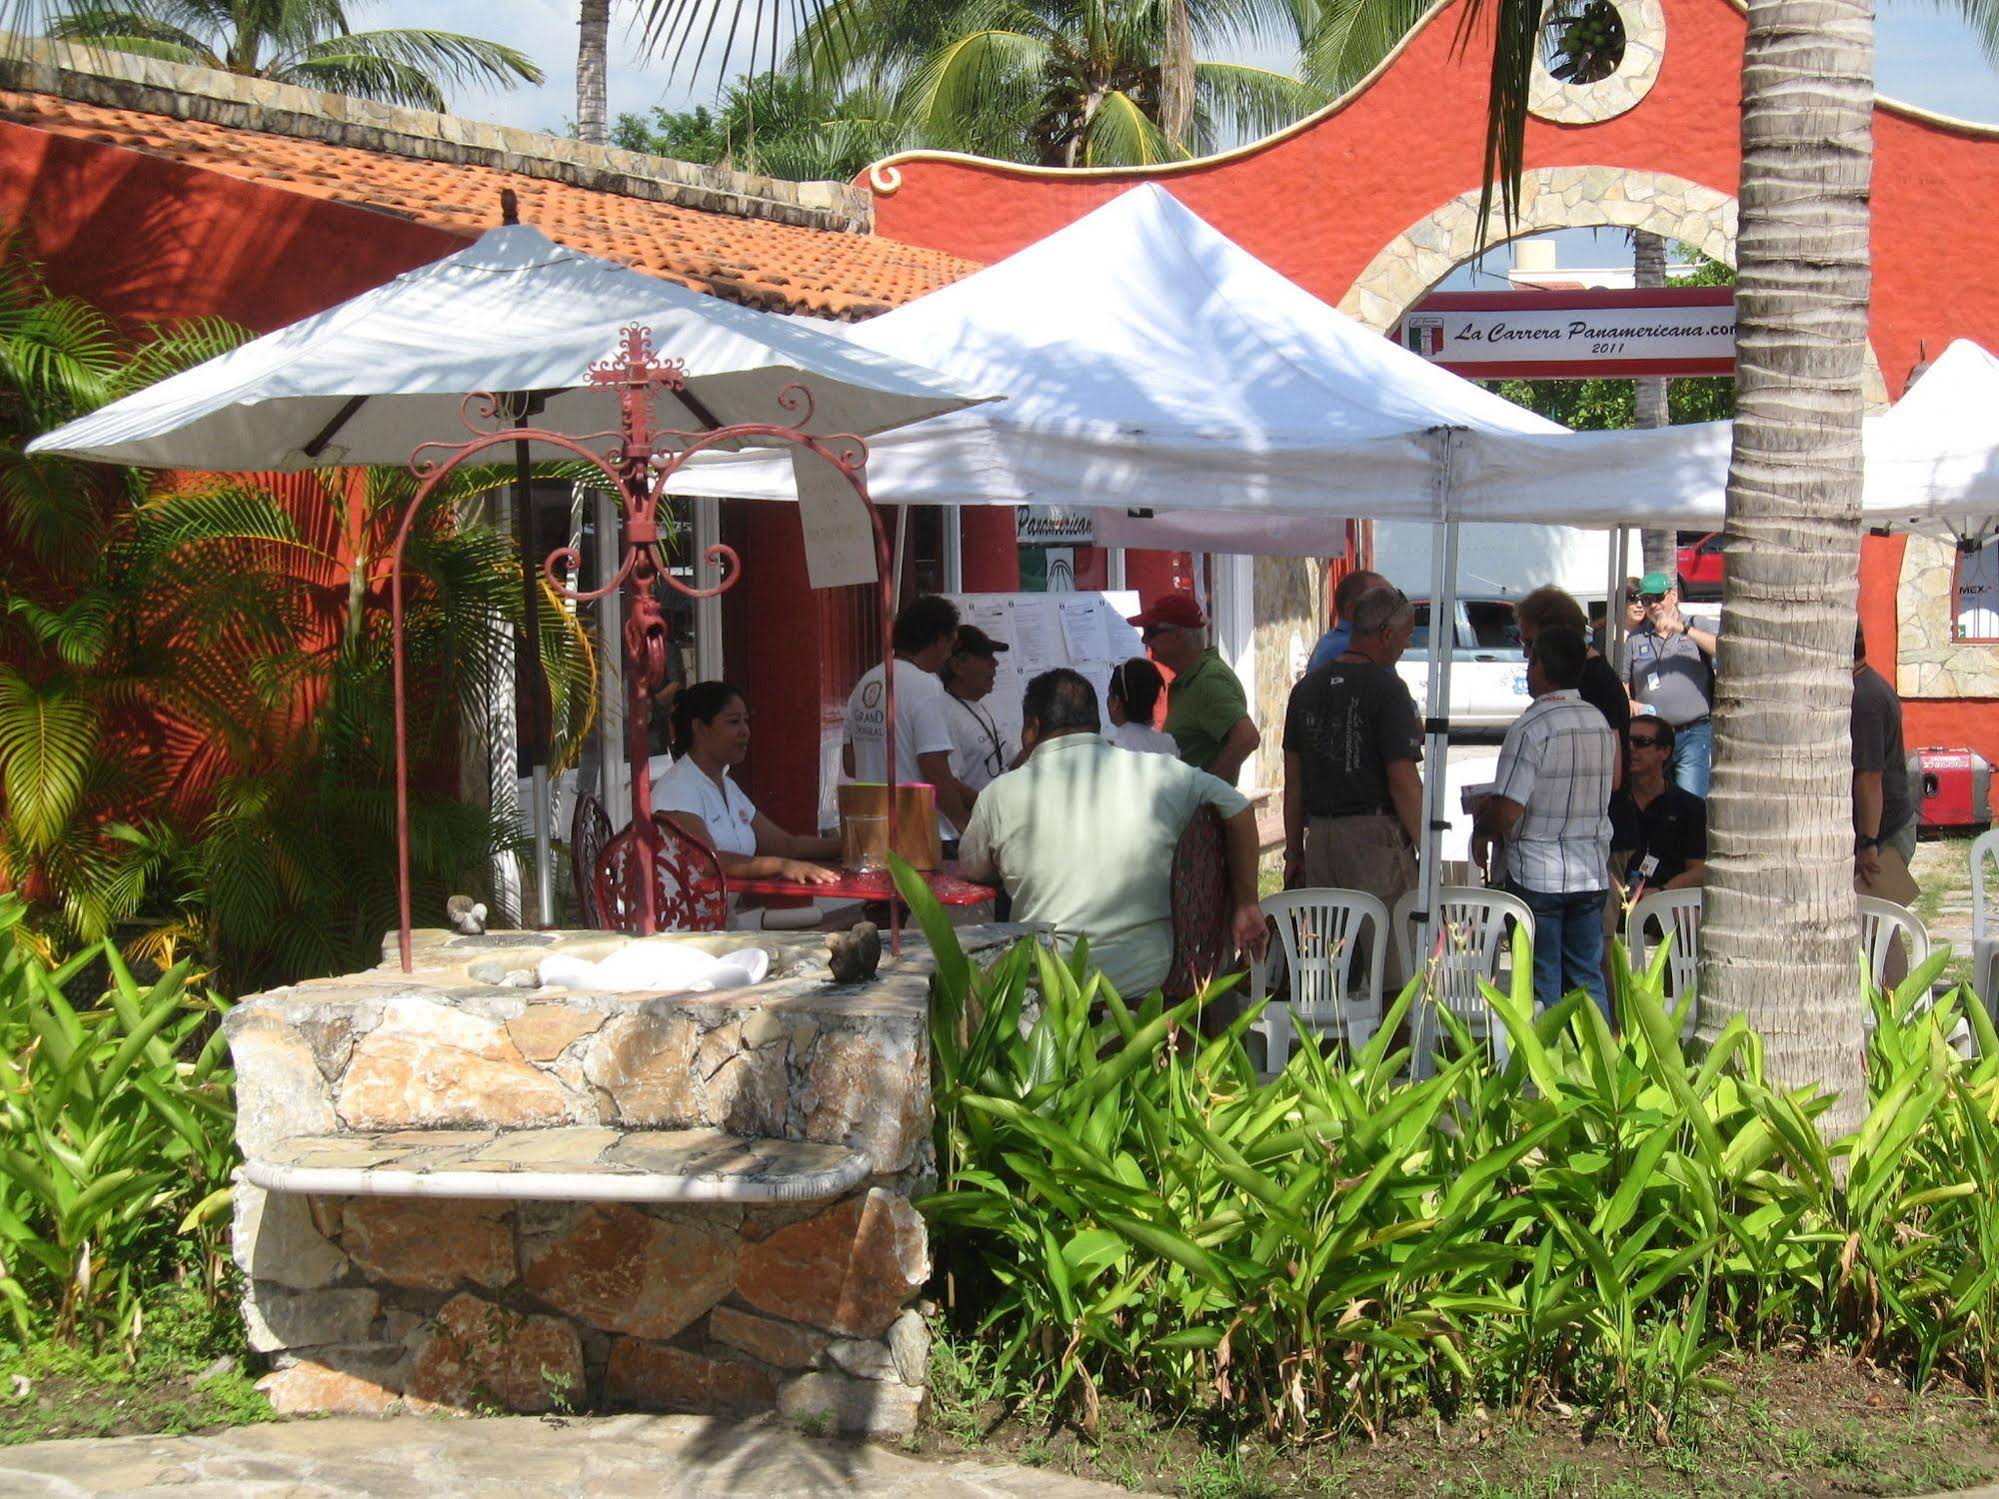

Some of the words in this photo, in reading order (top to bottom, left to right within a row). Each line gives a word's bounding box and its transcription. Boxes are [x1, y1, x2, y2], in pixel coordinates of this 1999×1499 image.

[1454, 323, 1483, 340] La
[1487, 323, 1562, 342] Carrera
[1591, 343, 1625, 354] 2011
